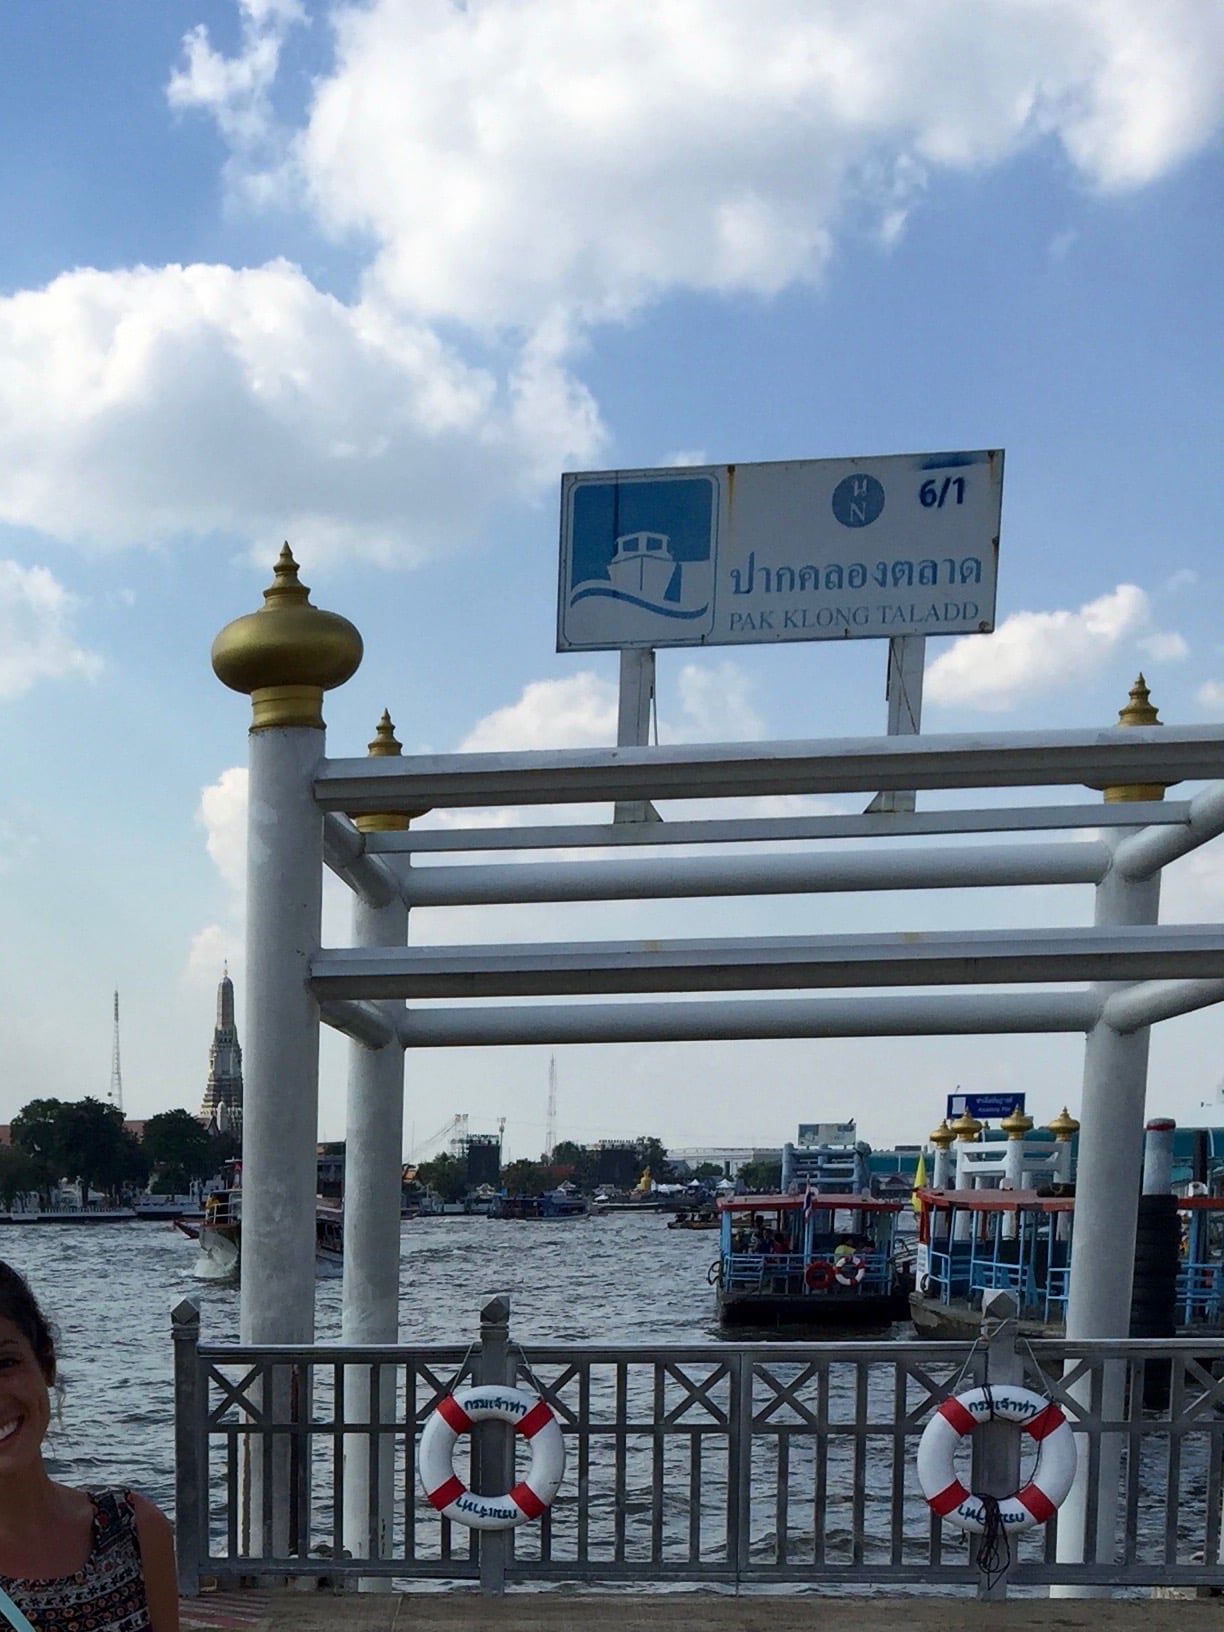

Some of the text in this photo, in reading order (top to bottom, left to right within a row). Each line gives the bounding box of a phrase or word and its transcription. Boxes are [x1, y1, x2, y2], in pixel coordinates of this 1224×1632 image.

[919, 476, 966, 509] 6/1
[849, 501, 867, 522] N
[730, 551, 982, 595] ปากคลองตลาด
[729, 602, 979, 631] PAK KLONG TALADD
